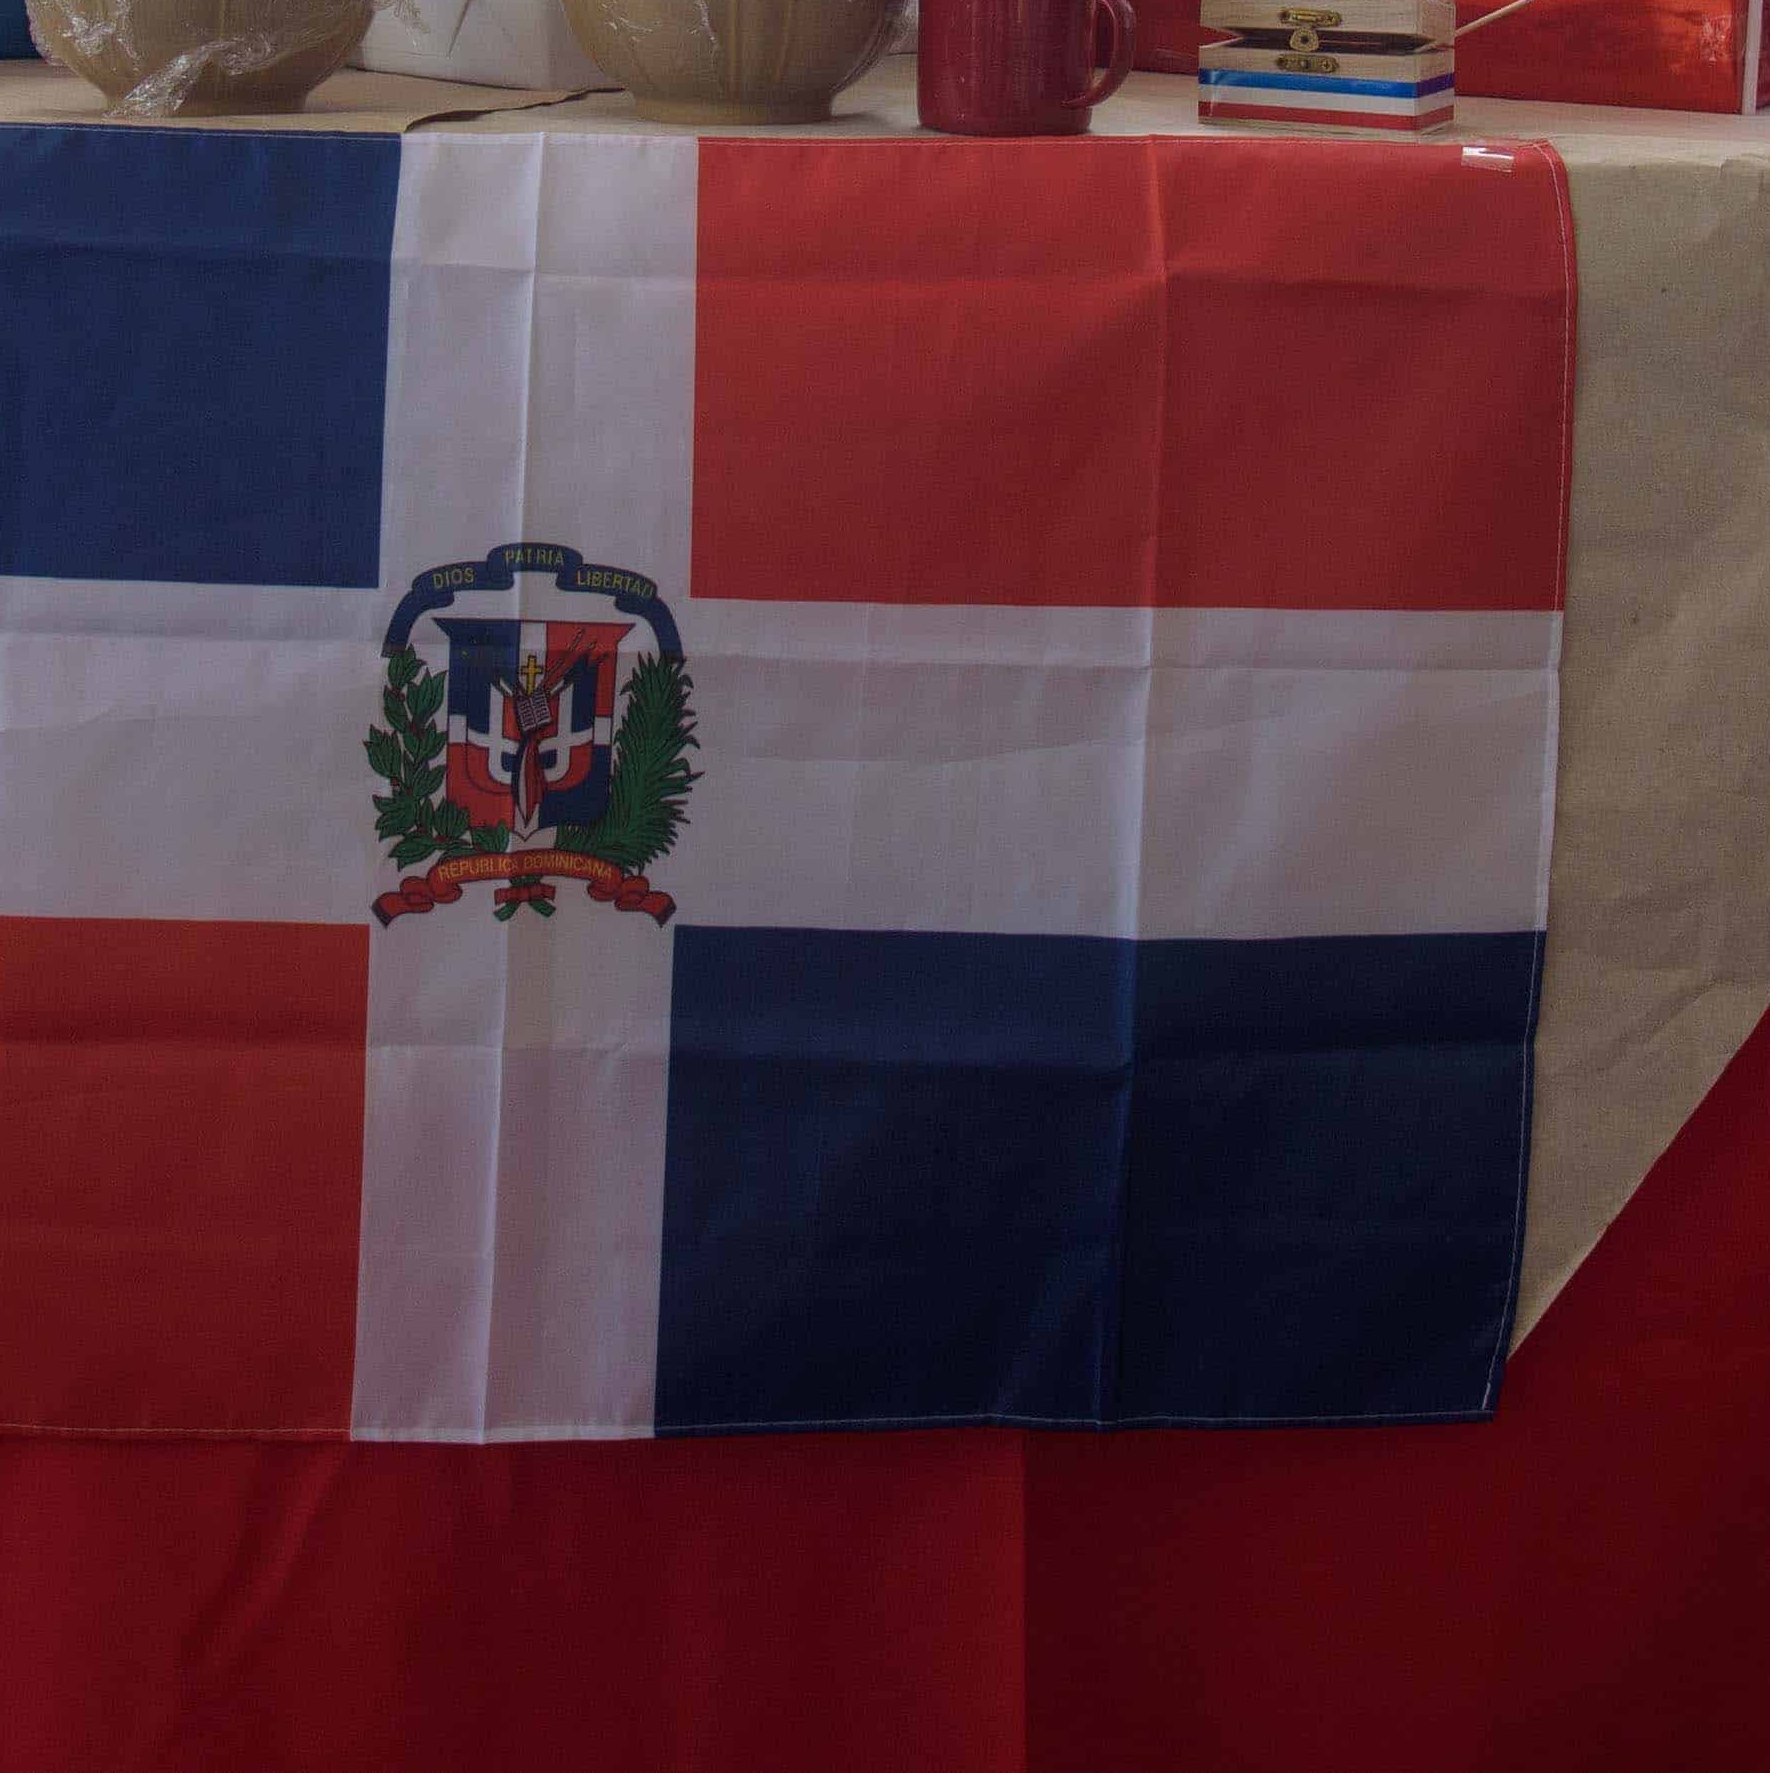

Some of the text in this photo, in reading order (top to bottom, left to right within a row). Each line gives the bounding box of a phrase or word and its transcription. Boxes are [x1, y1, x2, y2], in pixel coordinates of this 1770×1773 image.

[504, 547, 565, 567] PATRIA
[433, 567, 475, 590] DIOS
[577, 569, 654, 597] LIBERTAD
